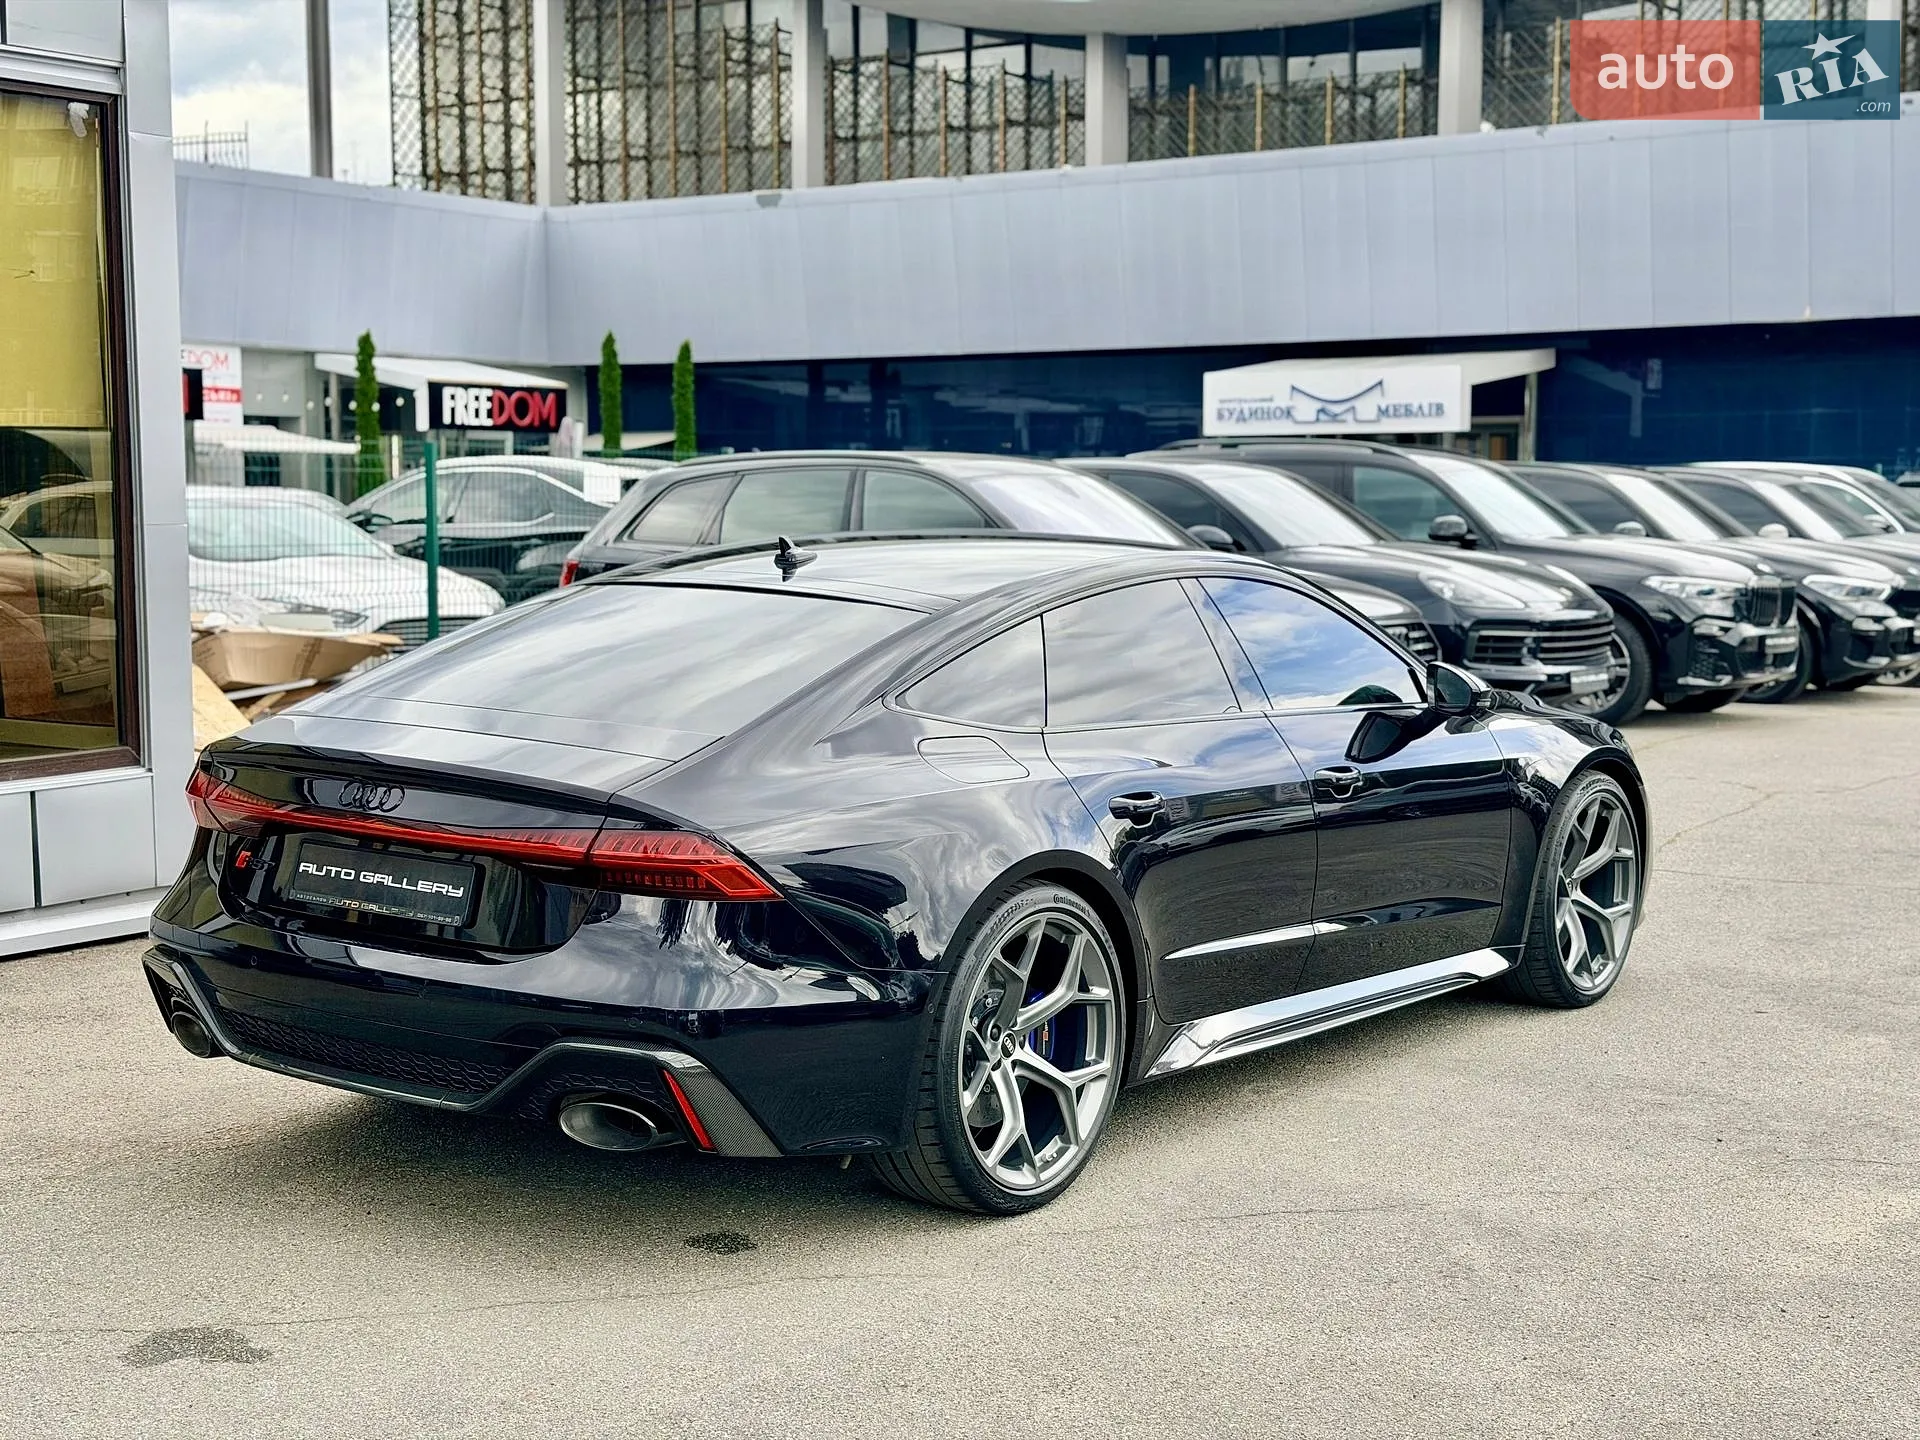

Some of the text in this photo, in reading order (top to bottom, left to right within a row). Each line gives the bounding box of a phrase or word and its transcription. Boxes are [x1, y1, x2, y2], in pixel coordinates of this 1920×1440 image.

[442, 386, 557, 428] FREEDOM
[299, 862, 465, 898] AUTO GALLERY
